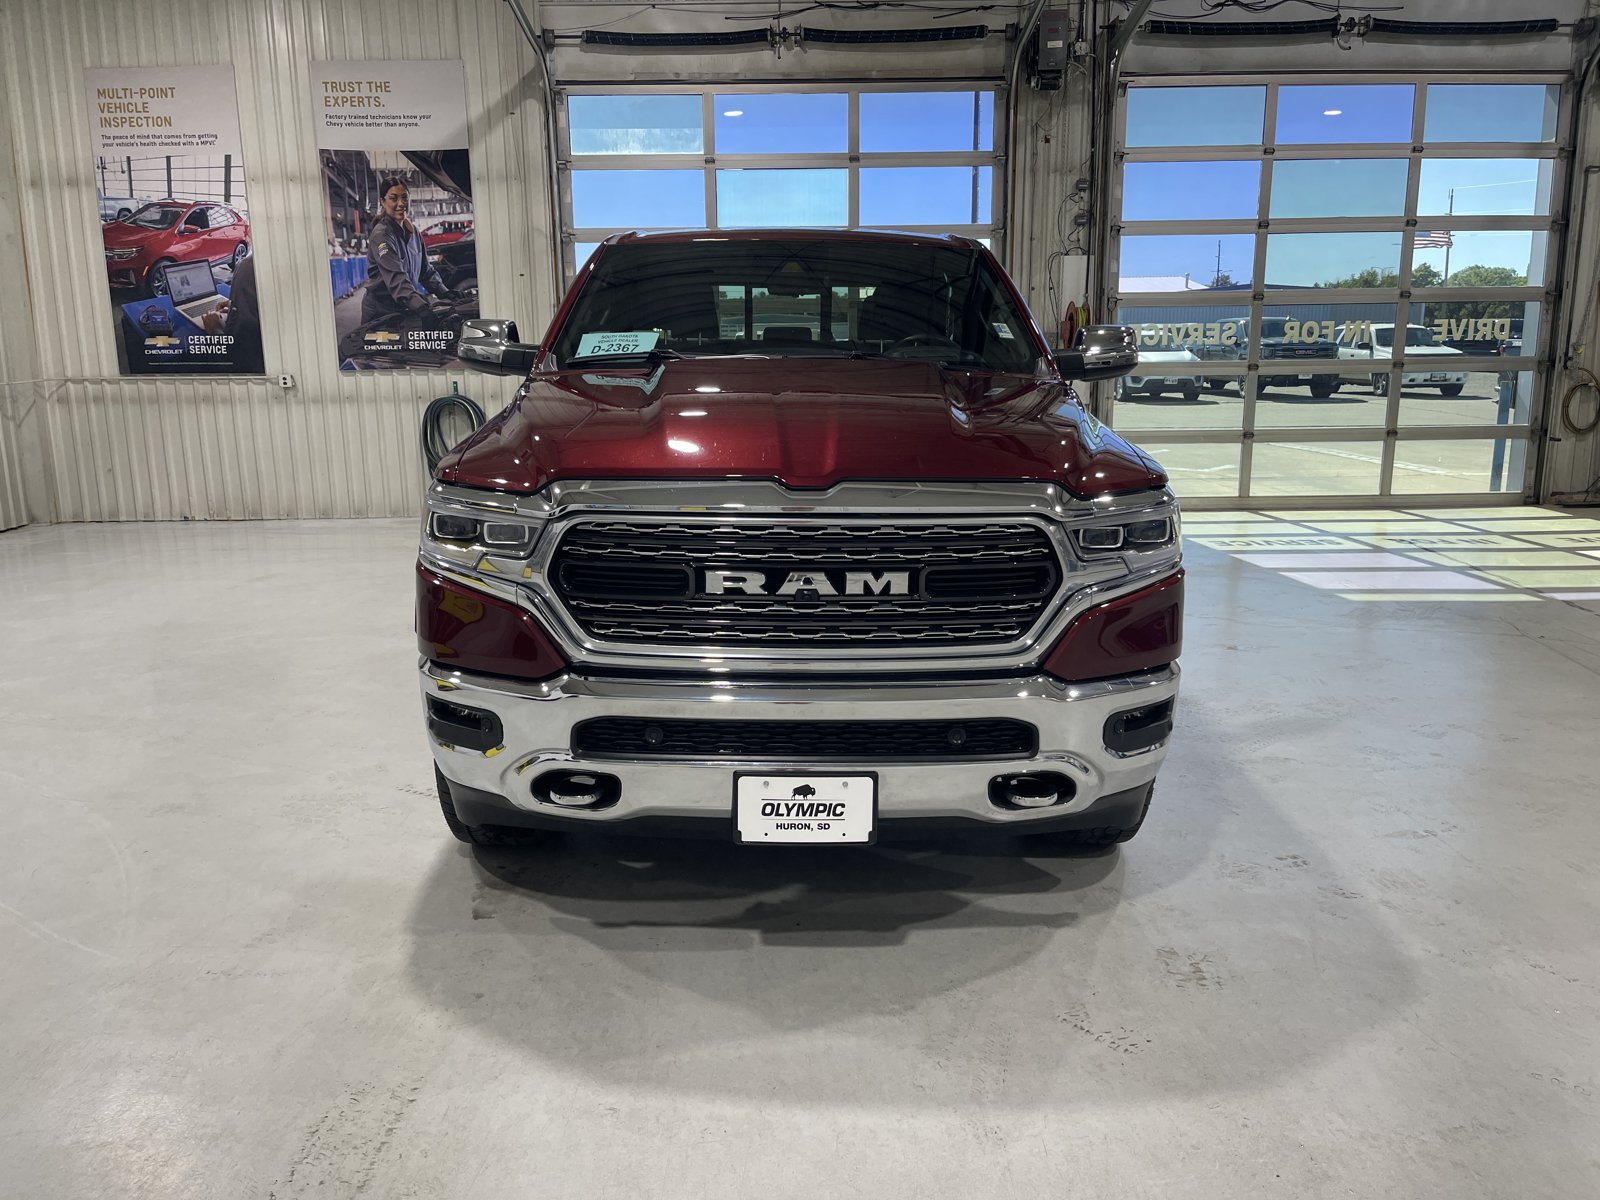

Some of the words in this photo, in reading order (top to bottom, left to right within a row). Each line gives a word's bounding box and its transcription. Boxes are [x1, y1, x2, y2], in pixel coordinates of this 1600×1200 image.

[97, 87, 176, 99] MULTI-POINT
[322, 81, 362, 93] TRUST
[366, 81, 392, 93] THE
[324, 95, 386, 108] EXPERTS.
[98, 102, 150, 114] VEHICLE
[100, 116, 173, 128] INSPECTION
[188, 335, 234, 344] CERTIFIED
[408, 331, 454, 340] CERTIFIED
[189, 345, 228, 354] SERVICE
[408, 341, 447, 350] SERVICE
[590, 343, 640, 354] D-2367
[705, 570, 909, 595] RAM
[761, 802, 846, 817] OLYMPIC
[776, 823, 813, 831] HURON,
